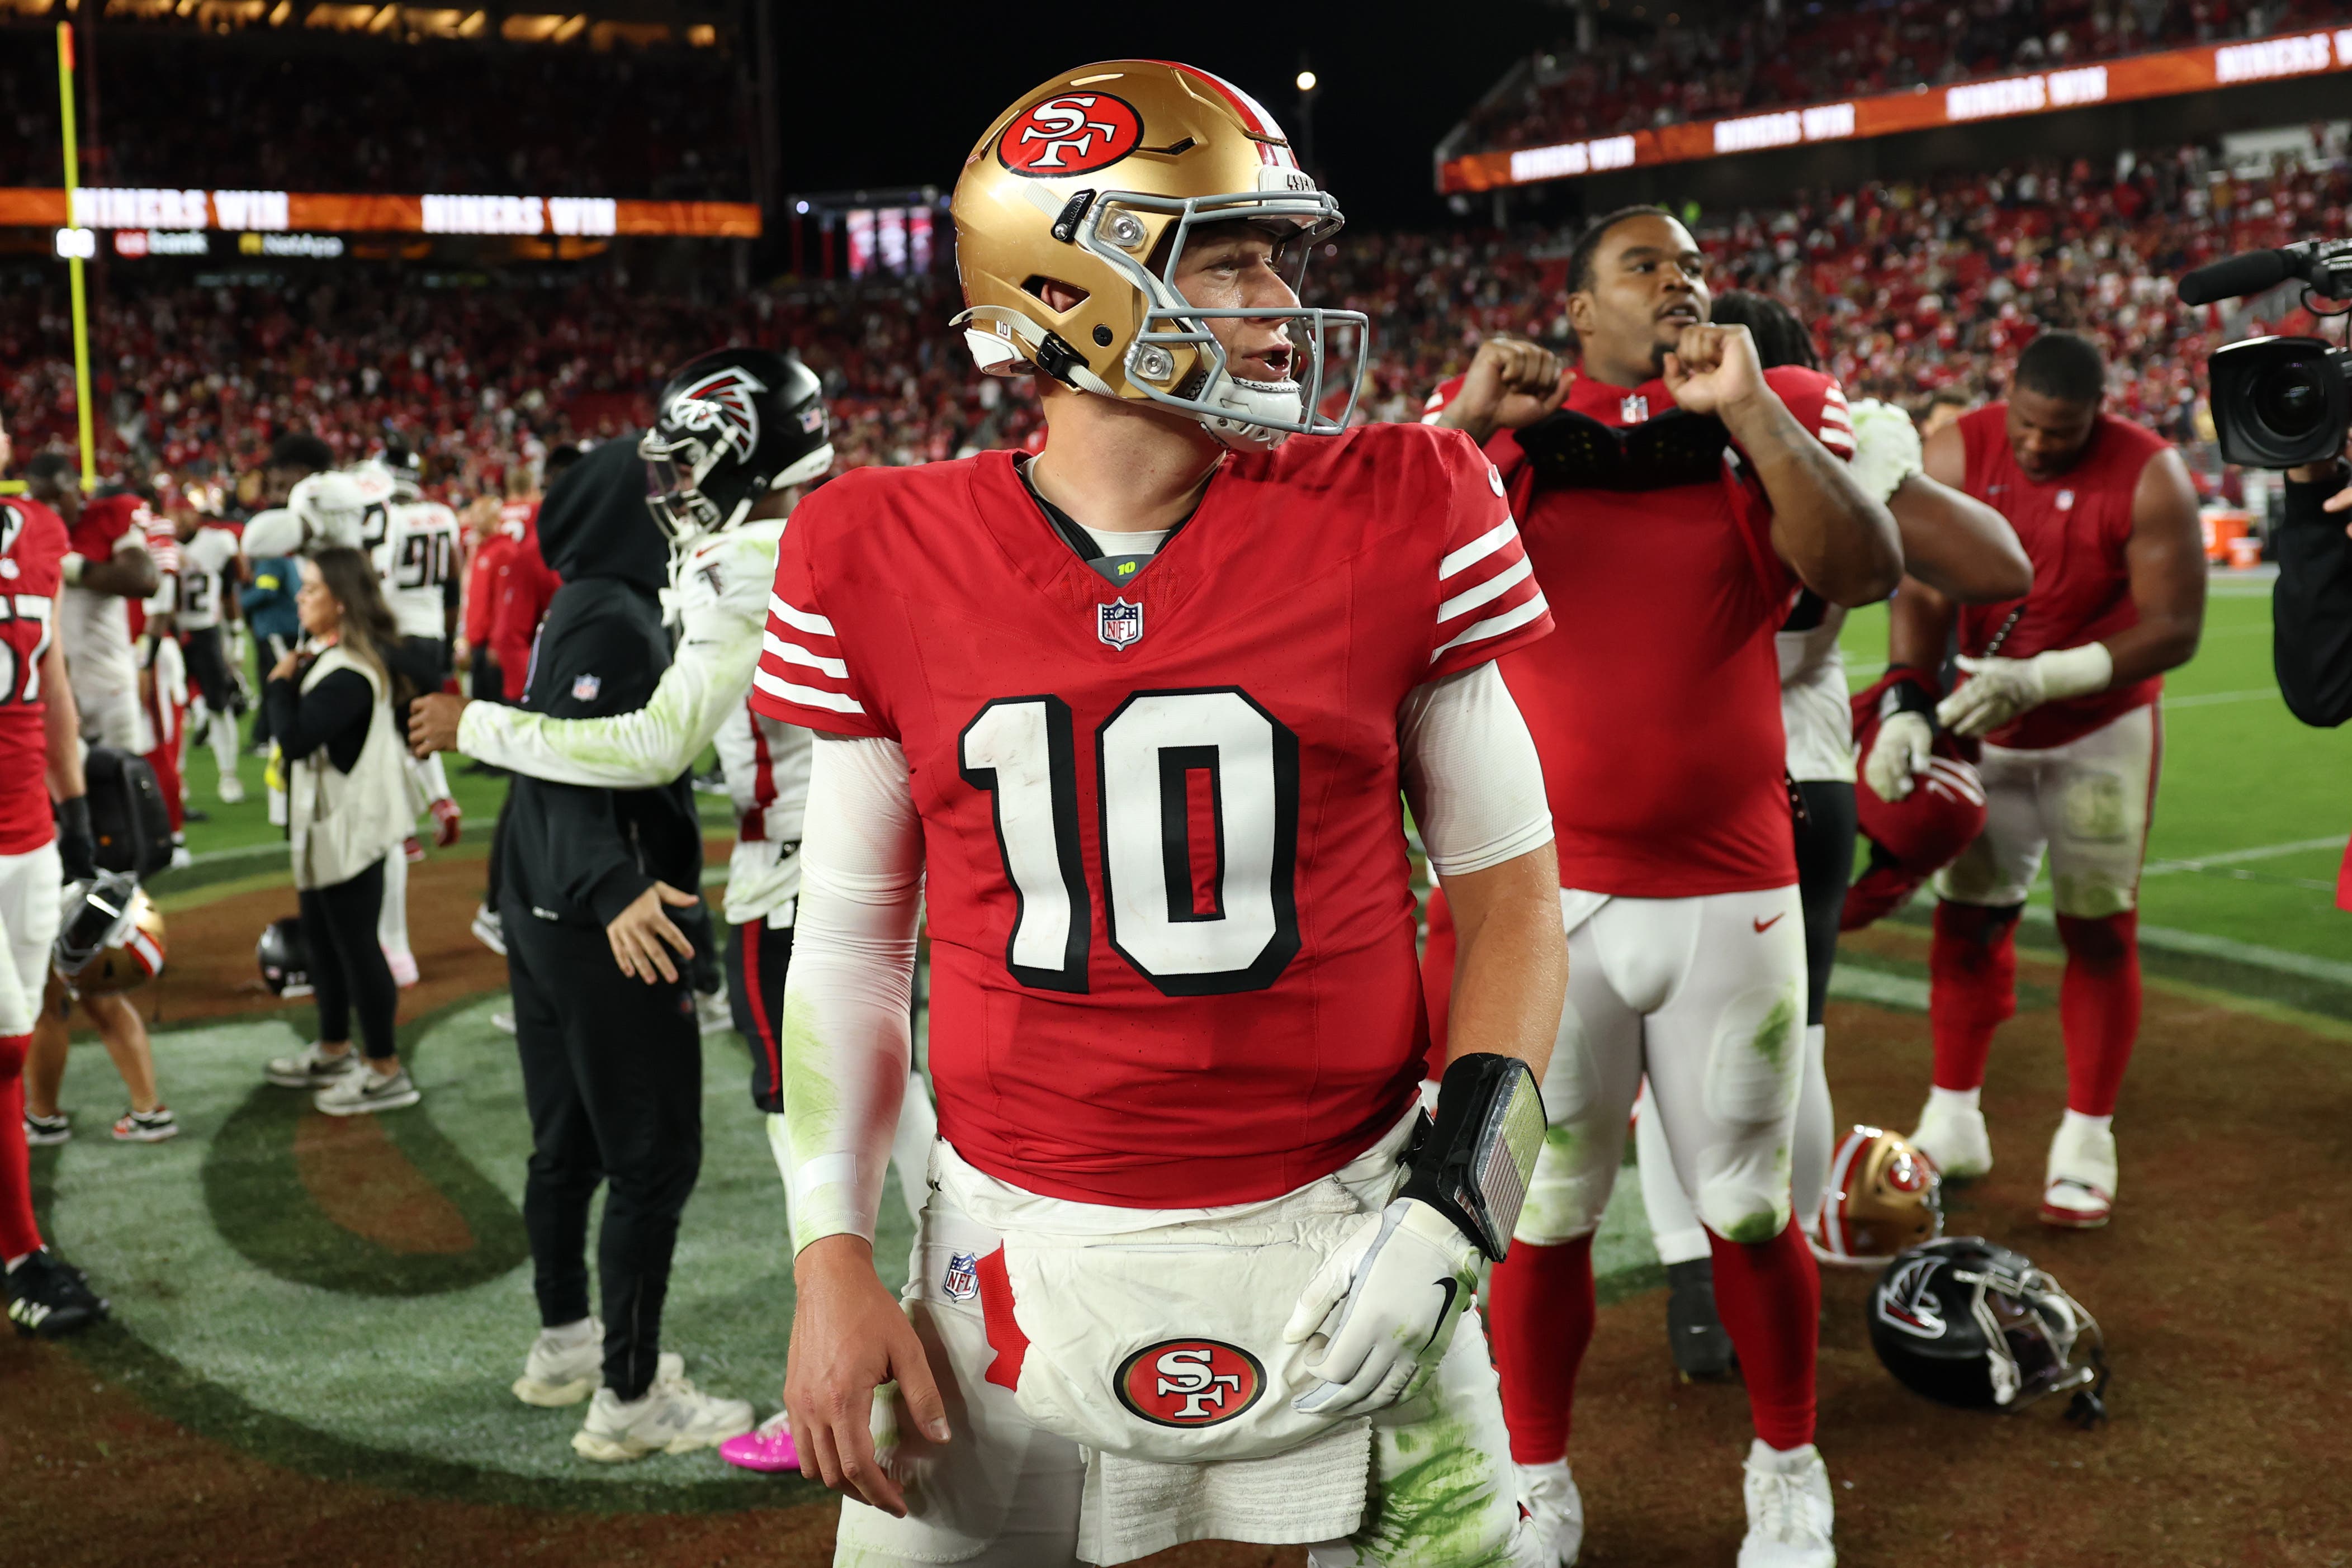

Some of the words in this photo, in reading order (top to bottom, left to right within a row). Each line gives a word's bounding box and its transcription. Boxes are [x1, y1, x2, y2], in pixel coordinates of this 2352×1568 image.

[73, 188, 206, 227] NINERS
[214, 191, 287, 229] WIN
[398, 530, 451, 590] 90
[1118, 561, 1136, 576] 10
[1106, 621, 1135, 640] NFL
[958, 685, 1302, 996] 10
[947, 1271, 972, 1292] NFL
